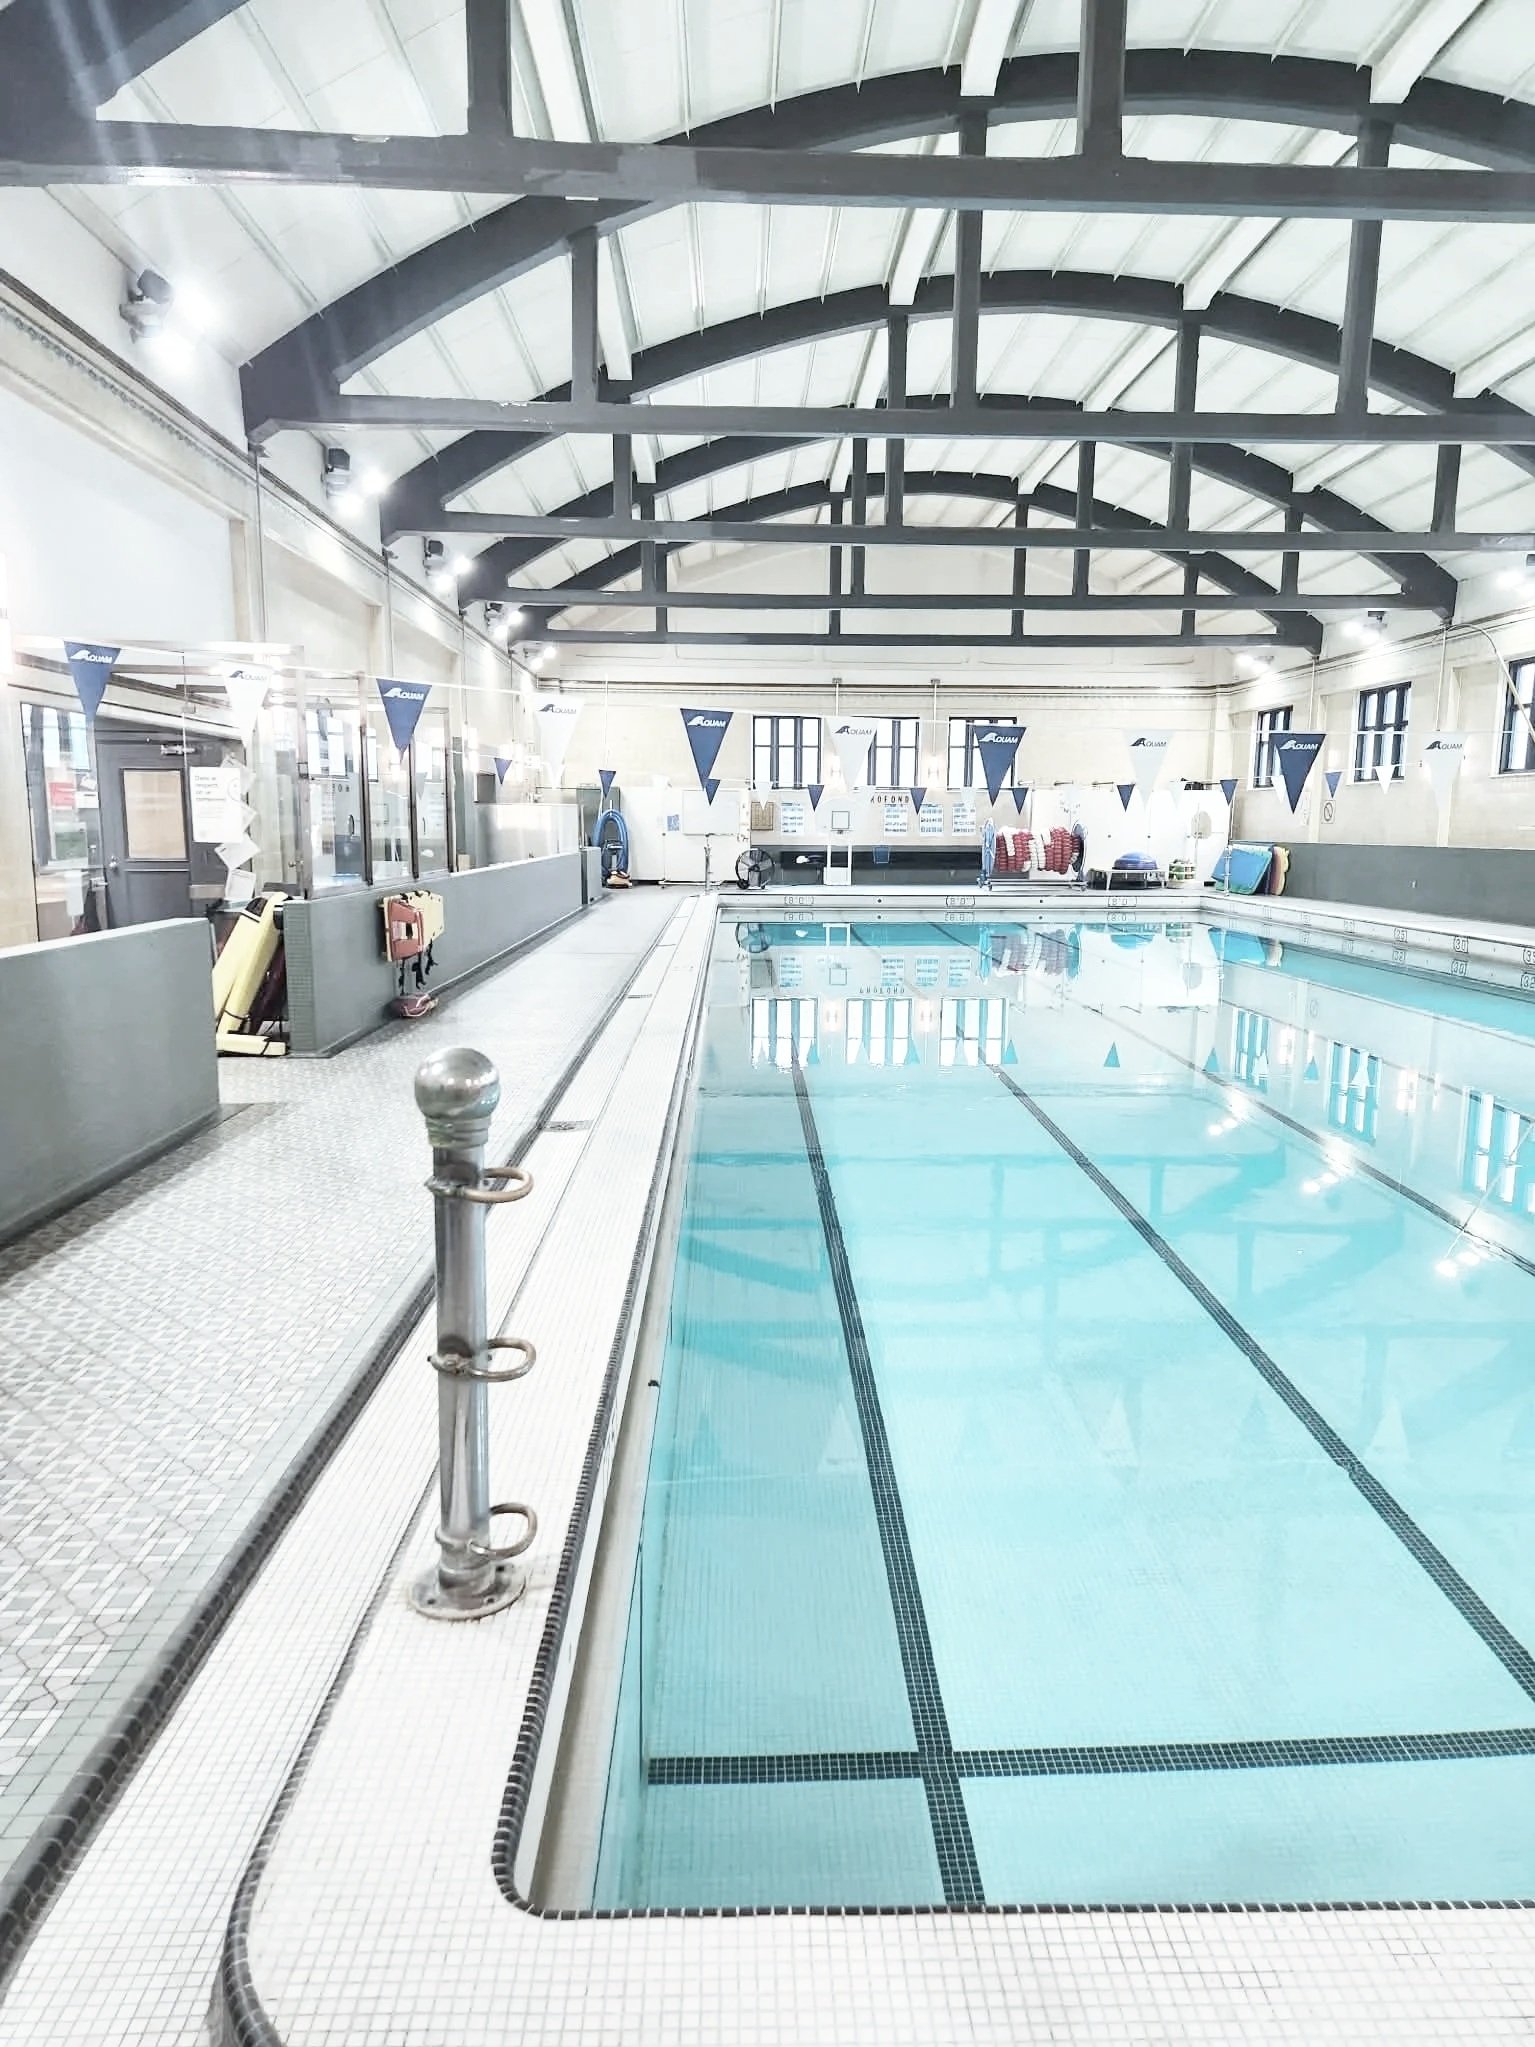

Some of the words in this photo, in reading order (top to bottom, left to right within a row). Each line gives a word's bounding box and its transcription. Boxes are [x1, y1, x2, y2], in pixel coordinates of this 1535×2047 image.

[979, 732, 1018, 744] AQUAM
[1130, 737, 1168, 747] AQUAM
[1280, 739, 1319, 750] AQUAM
[1424, 740, 1463, 750] AQUAM
